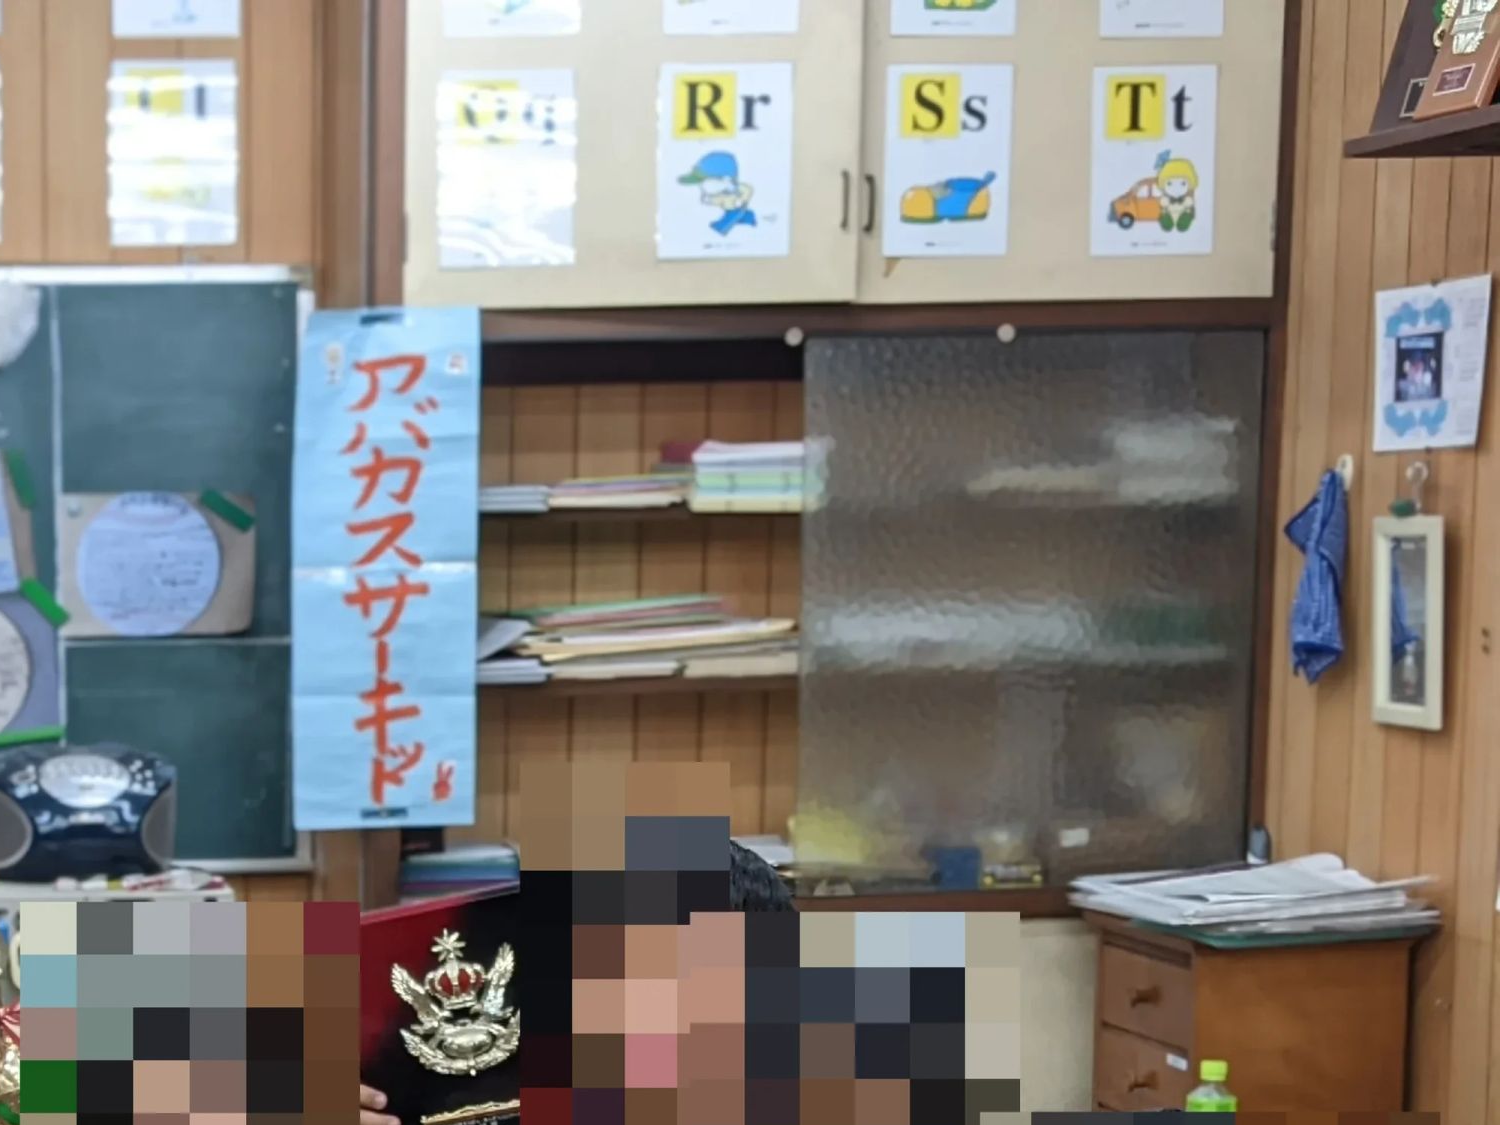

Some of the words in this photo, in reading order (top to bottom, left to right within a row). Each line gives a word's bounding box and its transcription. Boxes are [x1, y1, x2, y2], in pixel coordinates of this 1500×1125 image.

[681, 80, 772, 132] Rr
[911, 79, 988, 133] Ss
[1114, 81, 1193, 133] Tt
